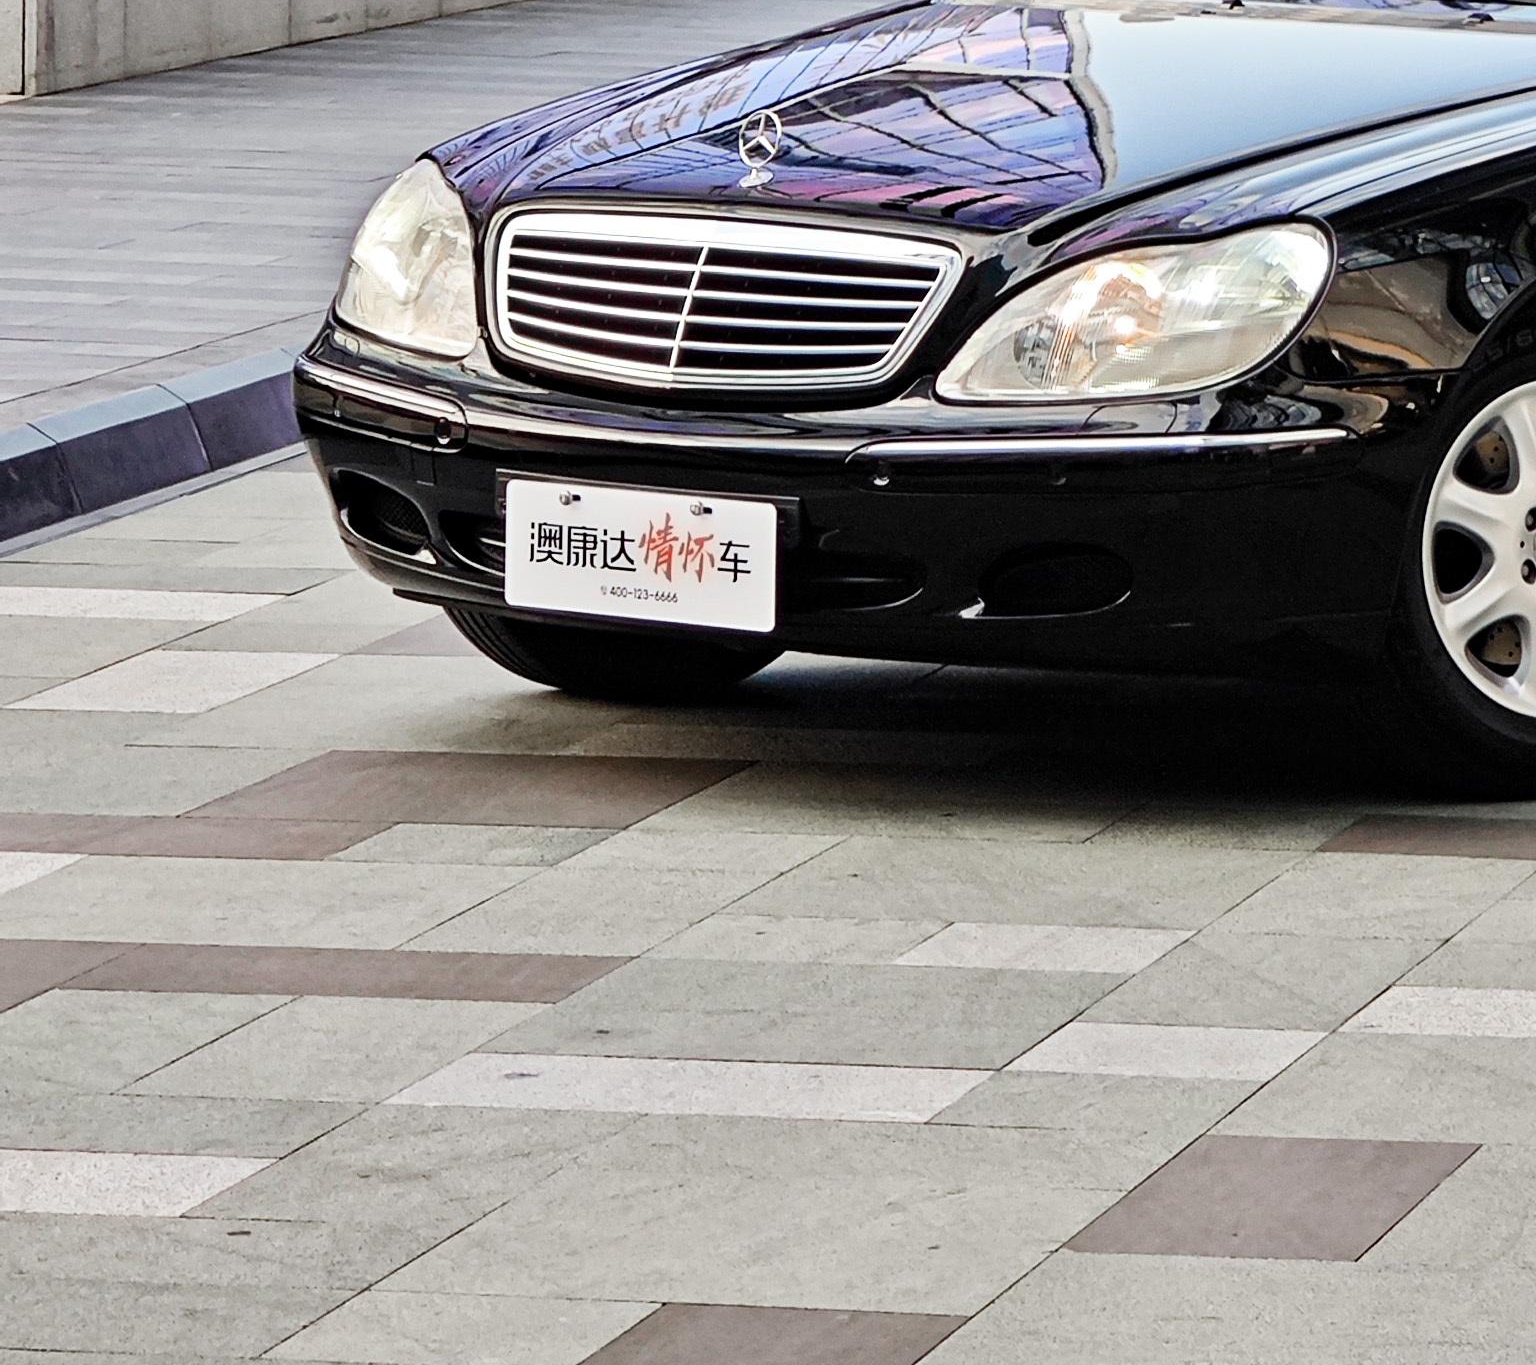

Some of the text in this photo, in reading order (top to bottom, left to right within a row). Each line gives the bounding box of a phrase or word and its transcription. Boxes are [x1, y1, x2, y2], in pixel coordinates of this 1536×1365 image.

[528, 512, 752, 584] 澳康达情怀车
[609, 585, 679, 604] 400-123-6666
